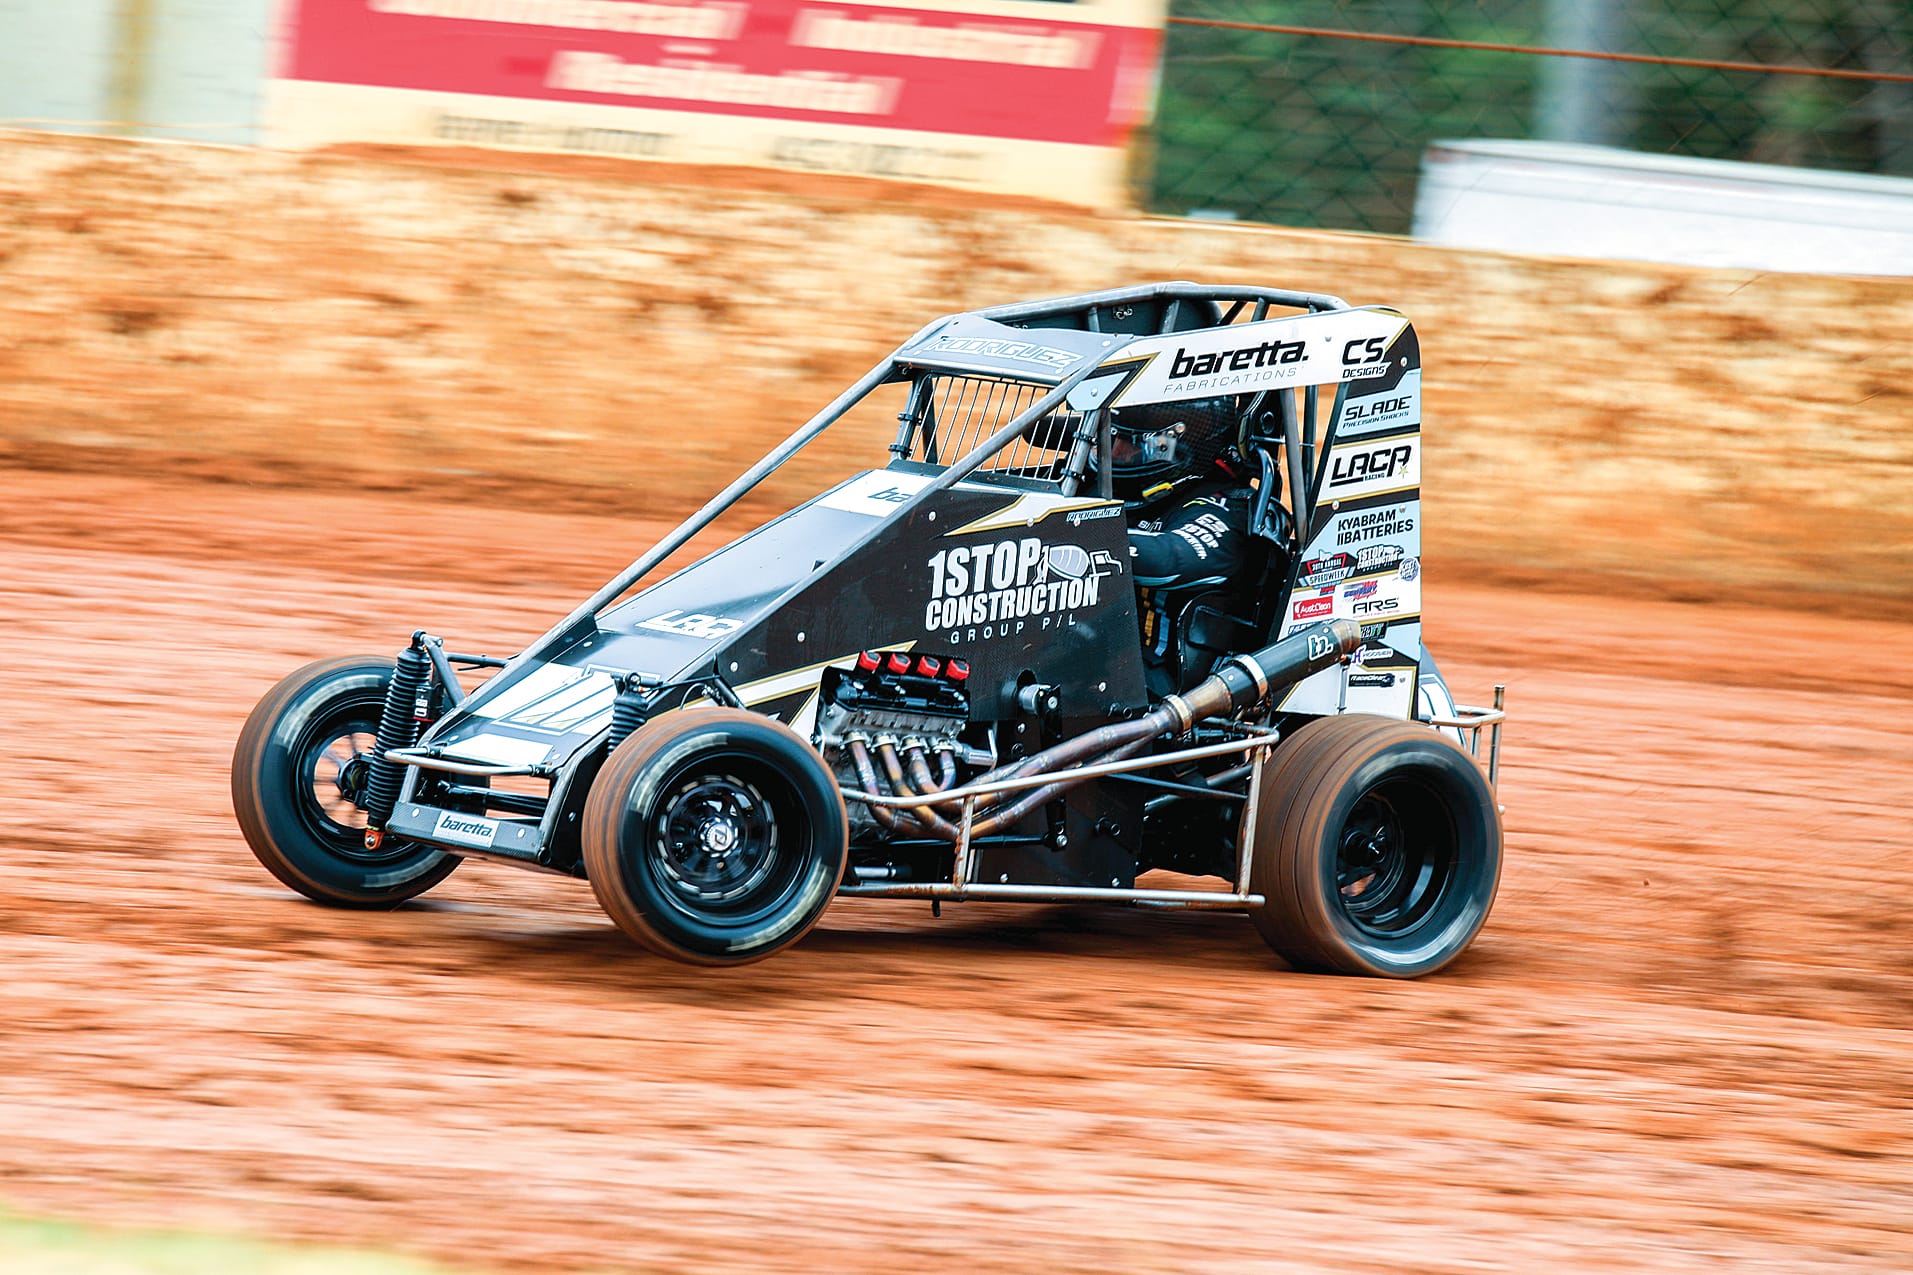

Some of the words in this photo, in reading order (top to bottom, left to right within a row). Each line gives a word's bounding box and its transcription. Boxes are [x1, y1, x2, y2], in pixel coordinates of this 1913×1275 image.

[1342, 336, 1388, 365] CS
[1163, 367, 1297, 394] FABRICATIONS
[1342, 364, 1386, 379] DESIGNS
[1344, 395, 1412, 421] SLADE
[1337, 509, 1396, 531] KYABRAM
[927, 538, 1042, 599] 1STOP
[925, 577, 1100, 631] CONSTRUCTION
[1353, 598, 1399, 614] ARS
[950, 623, 1024, 645] GROUP
[1041, 616, 1076, 631] P/L
